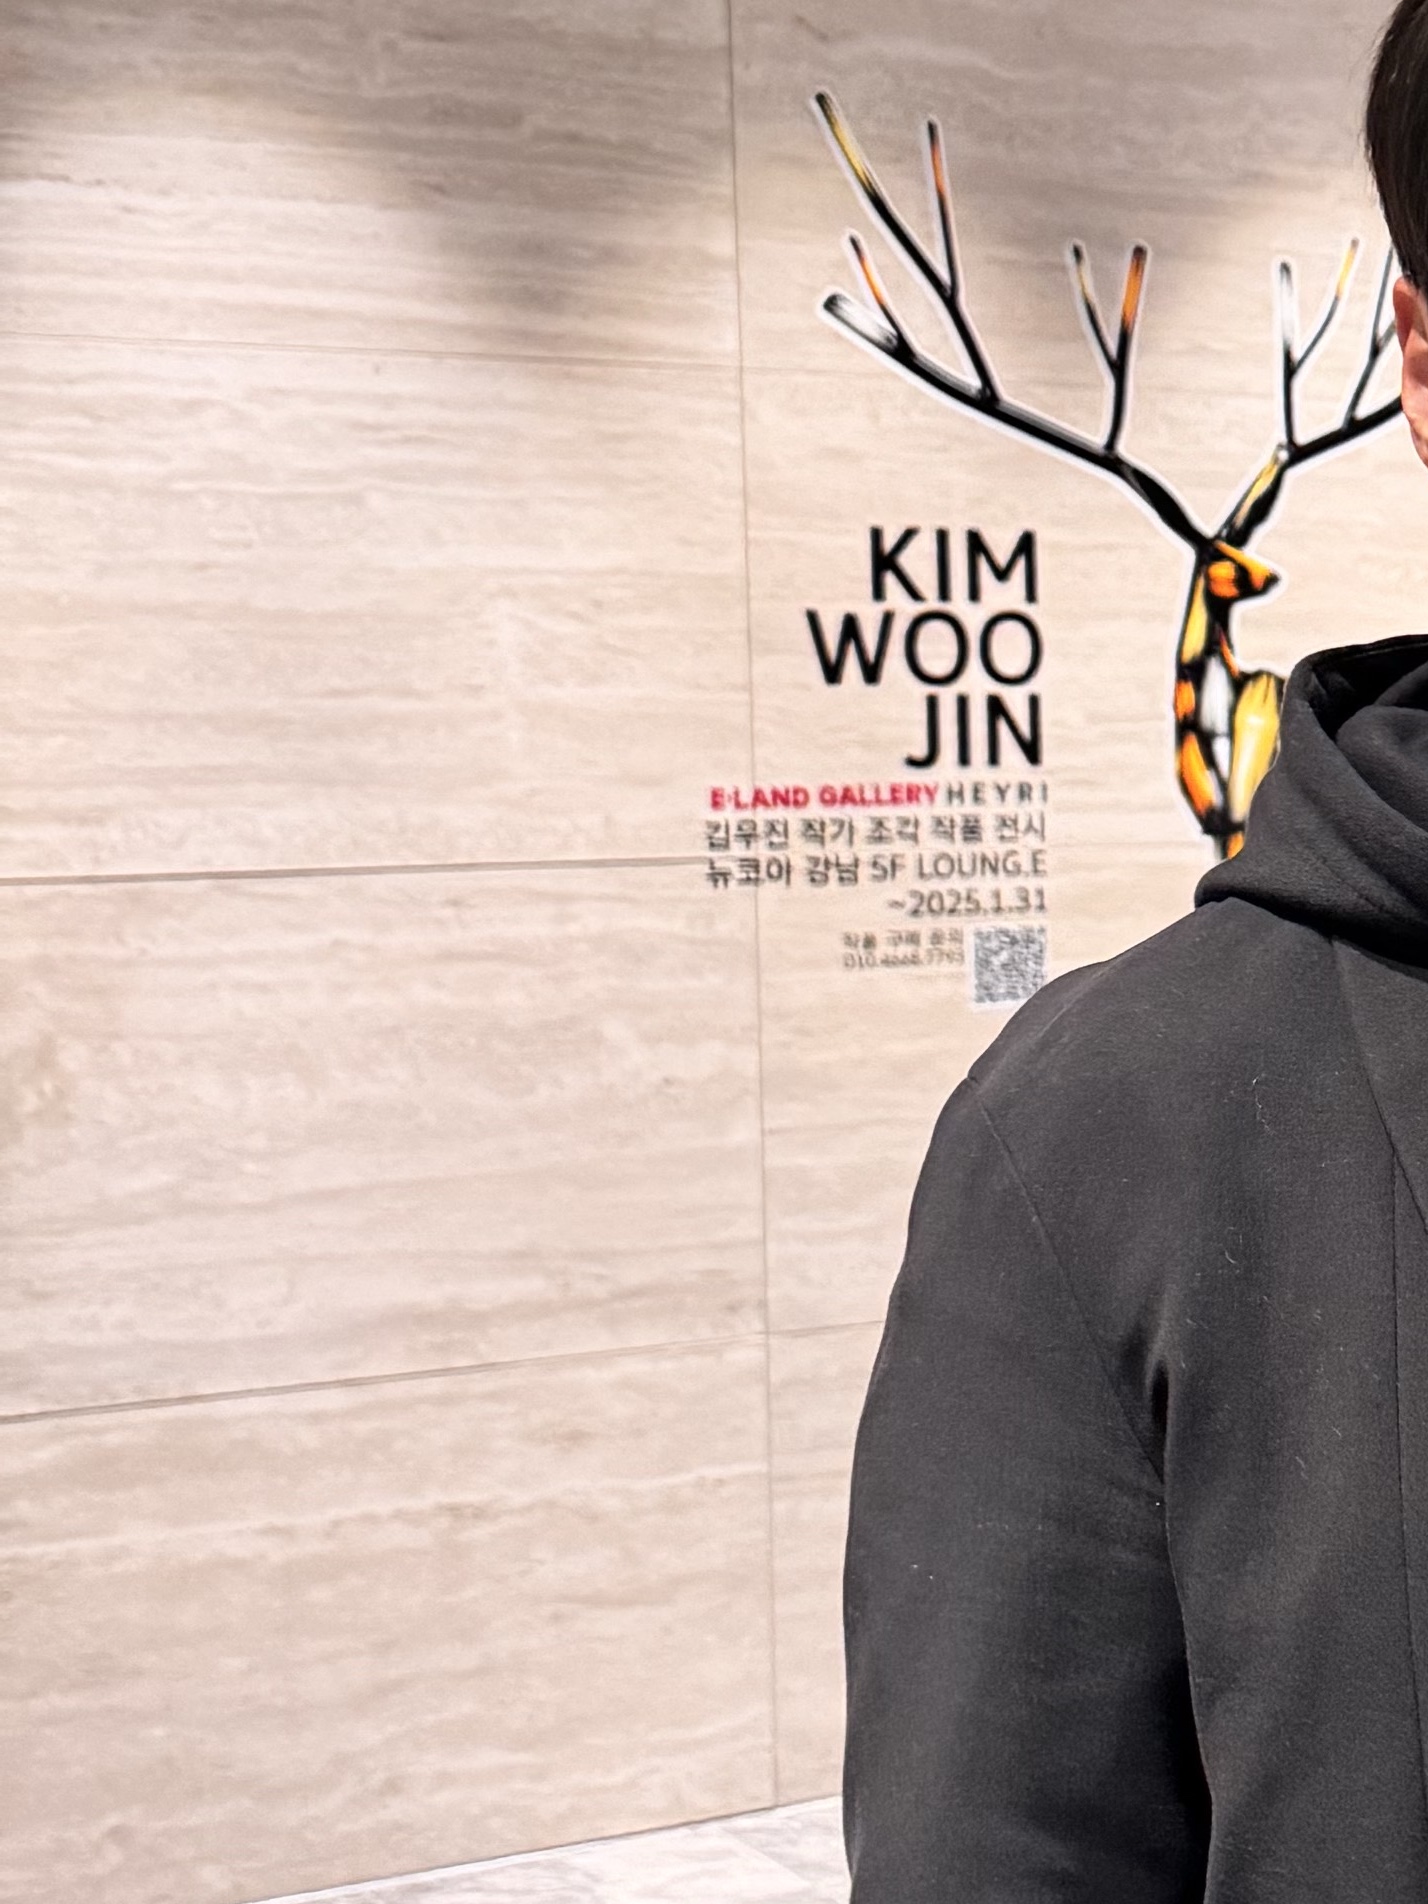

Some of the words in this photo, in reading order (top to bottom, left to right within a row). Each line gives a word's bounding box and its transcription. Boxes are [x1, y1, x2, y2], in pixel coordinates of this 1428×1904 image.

[869, 526, 1039, 604] KIM
[806, 609, 1044, 686] WOO
[905, 693, 1043, 768] JIN
[818, 783, 940, 808] GALLERY
[946, 782, 1049, 807] HEYRI
[704, 818, 791, 851] 김우진
[800, 816, 856, 848] 작가
[865, 815, 920, 844] 조각
[930, 814, 984, 844] 작품
[994, 812, 1047, 843] 전시
[705, 855, 792, 888] 뉴코아
[805, 854, 859, 886] 강남
[871, 852, 906, 881] SF
